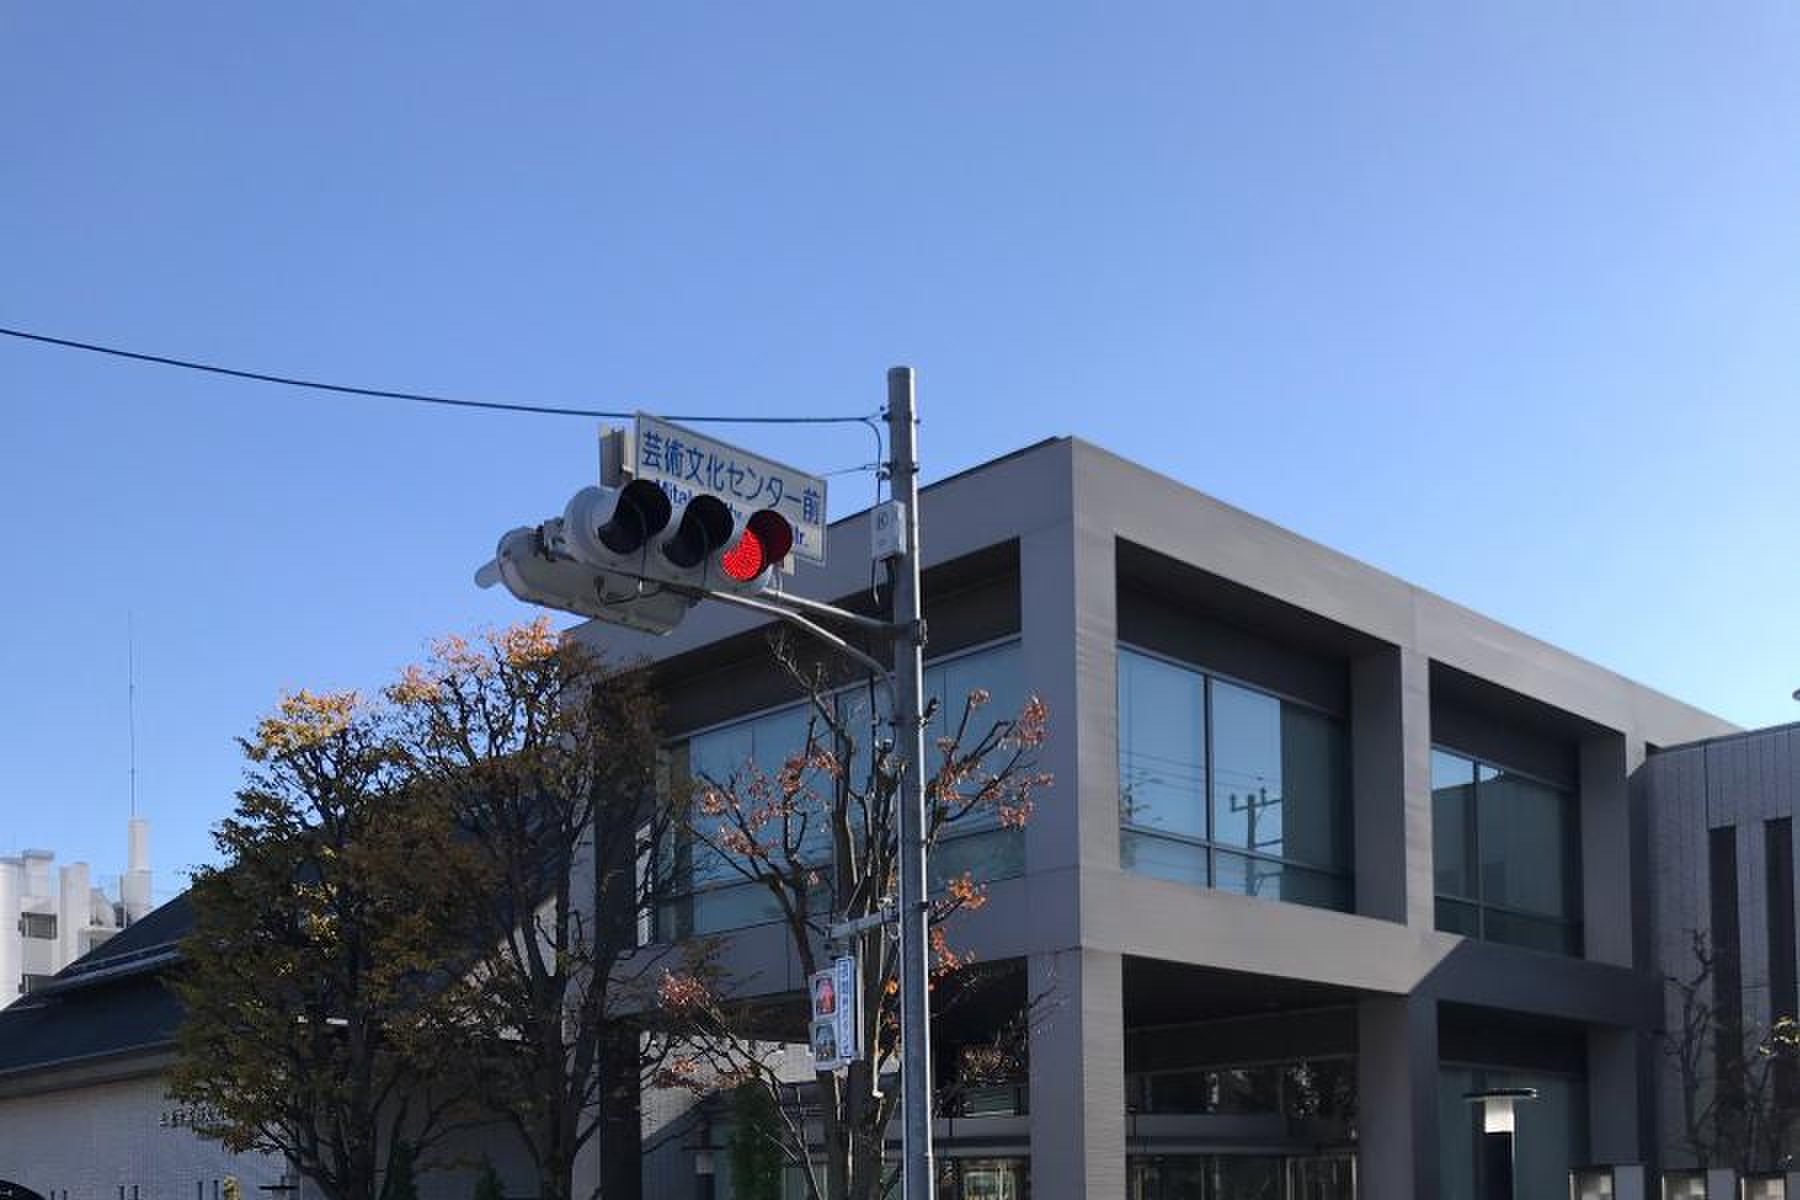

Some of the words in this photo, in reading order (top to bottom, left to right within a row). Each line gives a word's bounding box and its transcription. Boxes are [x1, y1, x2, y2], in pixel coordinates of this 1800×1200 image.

[641, 431, 821, 525] 芸術文化センター前
